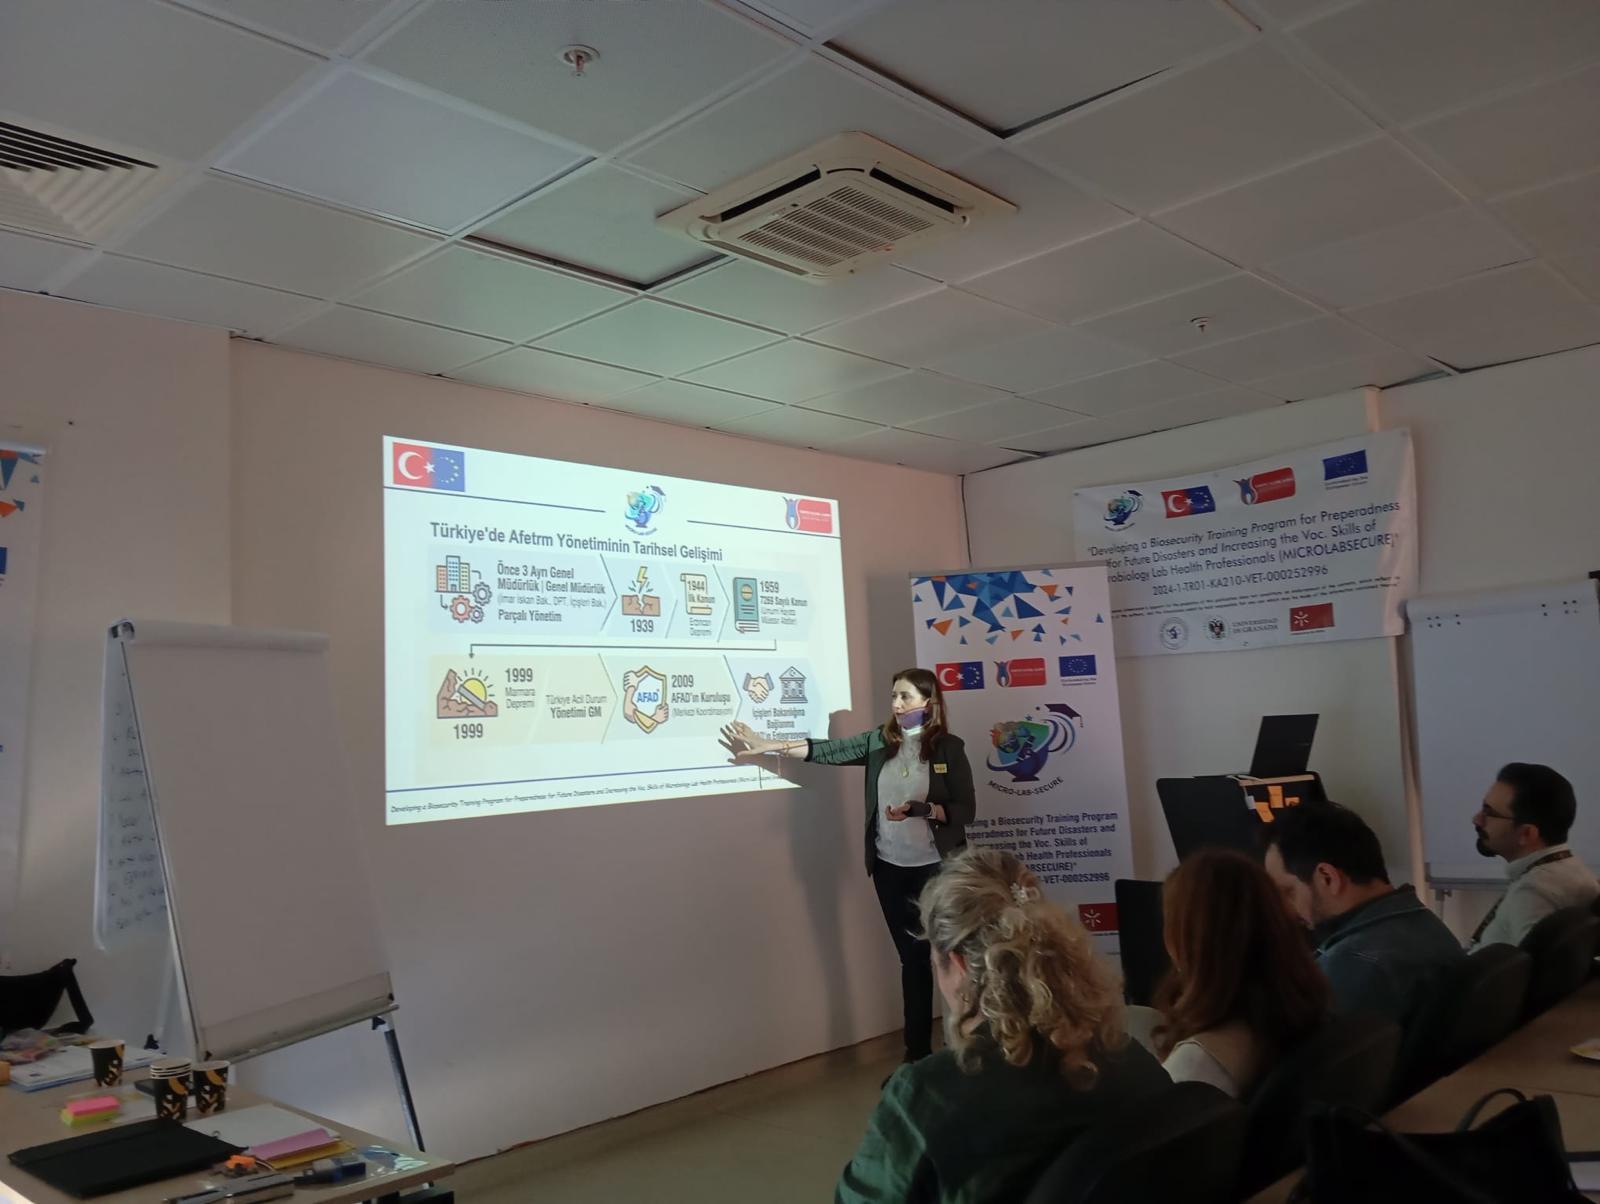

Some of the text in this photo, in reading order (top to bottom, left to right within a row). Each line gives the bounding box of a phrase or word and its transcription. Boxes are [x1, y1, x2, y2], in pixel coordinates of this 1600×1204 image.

[1150, 532, 1203, 546] Biosecurity
[1207, 527, 1248, 541] Training
[1250, 517, 1297, 533] Program
[1300, 512, 1316, 525] for
[1320, 501, 1400, 522] Preperadness
[430, 522, 505, 544] Türkiye'de
[557, 534, 630, 554] Yönetiminin
[633, 540, 678, 558] Tarihsel
[680, 545, 723, 562] Gelişimi
[1124, 556, 1150, 568] Future
[1154, 548, 1196, 562] Disasters
[1198, 544, 1218, 556] and
[1221, 534, 1277, 552] Increasing
[1280, 532, 1298, 544] the
[1301, 528, 1327, 541] Voc.
[1332, 524, 1360, 538] Skills
[1364, 519, 1376, 532] of
[497, 560, 520, 576] Önce
[522, 564, 528, 576] 3
[550, 566, 574, 579] Genel
[1152, 566, 1168, 578] Lab
[1171, 562, 1202, 576] Health
[1206, 551, 1275, 570] Professionals
[498, 578, 540, 592] Müdürlük
[546, 580, 568, 592] Genel
[687, 580, 704, 592] 1944
[760, 580, 780, 593] 1959
[529, 610, 562, 622] Yönetim
[630, 619, 654, 632] 1939
[505, 668, 533, 683] 1999
[672, 674, 694, 688] 2009
[636, 692, 659, 703] AFAD
[550, 706, 586, 720] Yönetimi
[454, 723, 484, 740] 1999
[988, 776, 1064, 796] MICRO-LAB-SECURE
[998, 815, 1044, 826] Biosecurity
[1046, 814, 1080, 824] Training
[1082, 812, 1118, 823] Program
[1016, 827, 1030, 838] for
[1030, 826, 1056, 837] Future
[1059, 824, 1098, 835] Disasters
[1100, 824, 1116, 833] and
[1018, 840, 1032, 848] the
[1034, 838, 1051, 848] Voc.
[1054, 838, 1078, 848] Skills
[1080, 836, 1088, 846] of
[1026, 850, 1054, 861] Health
[1056, 848, 1112, 860] Professionals
